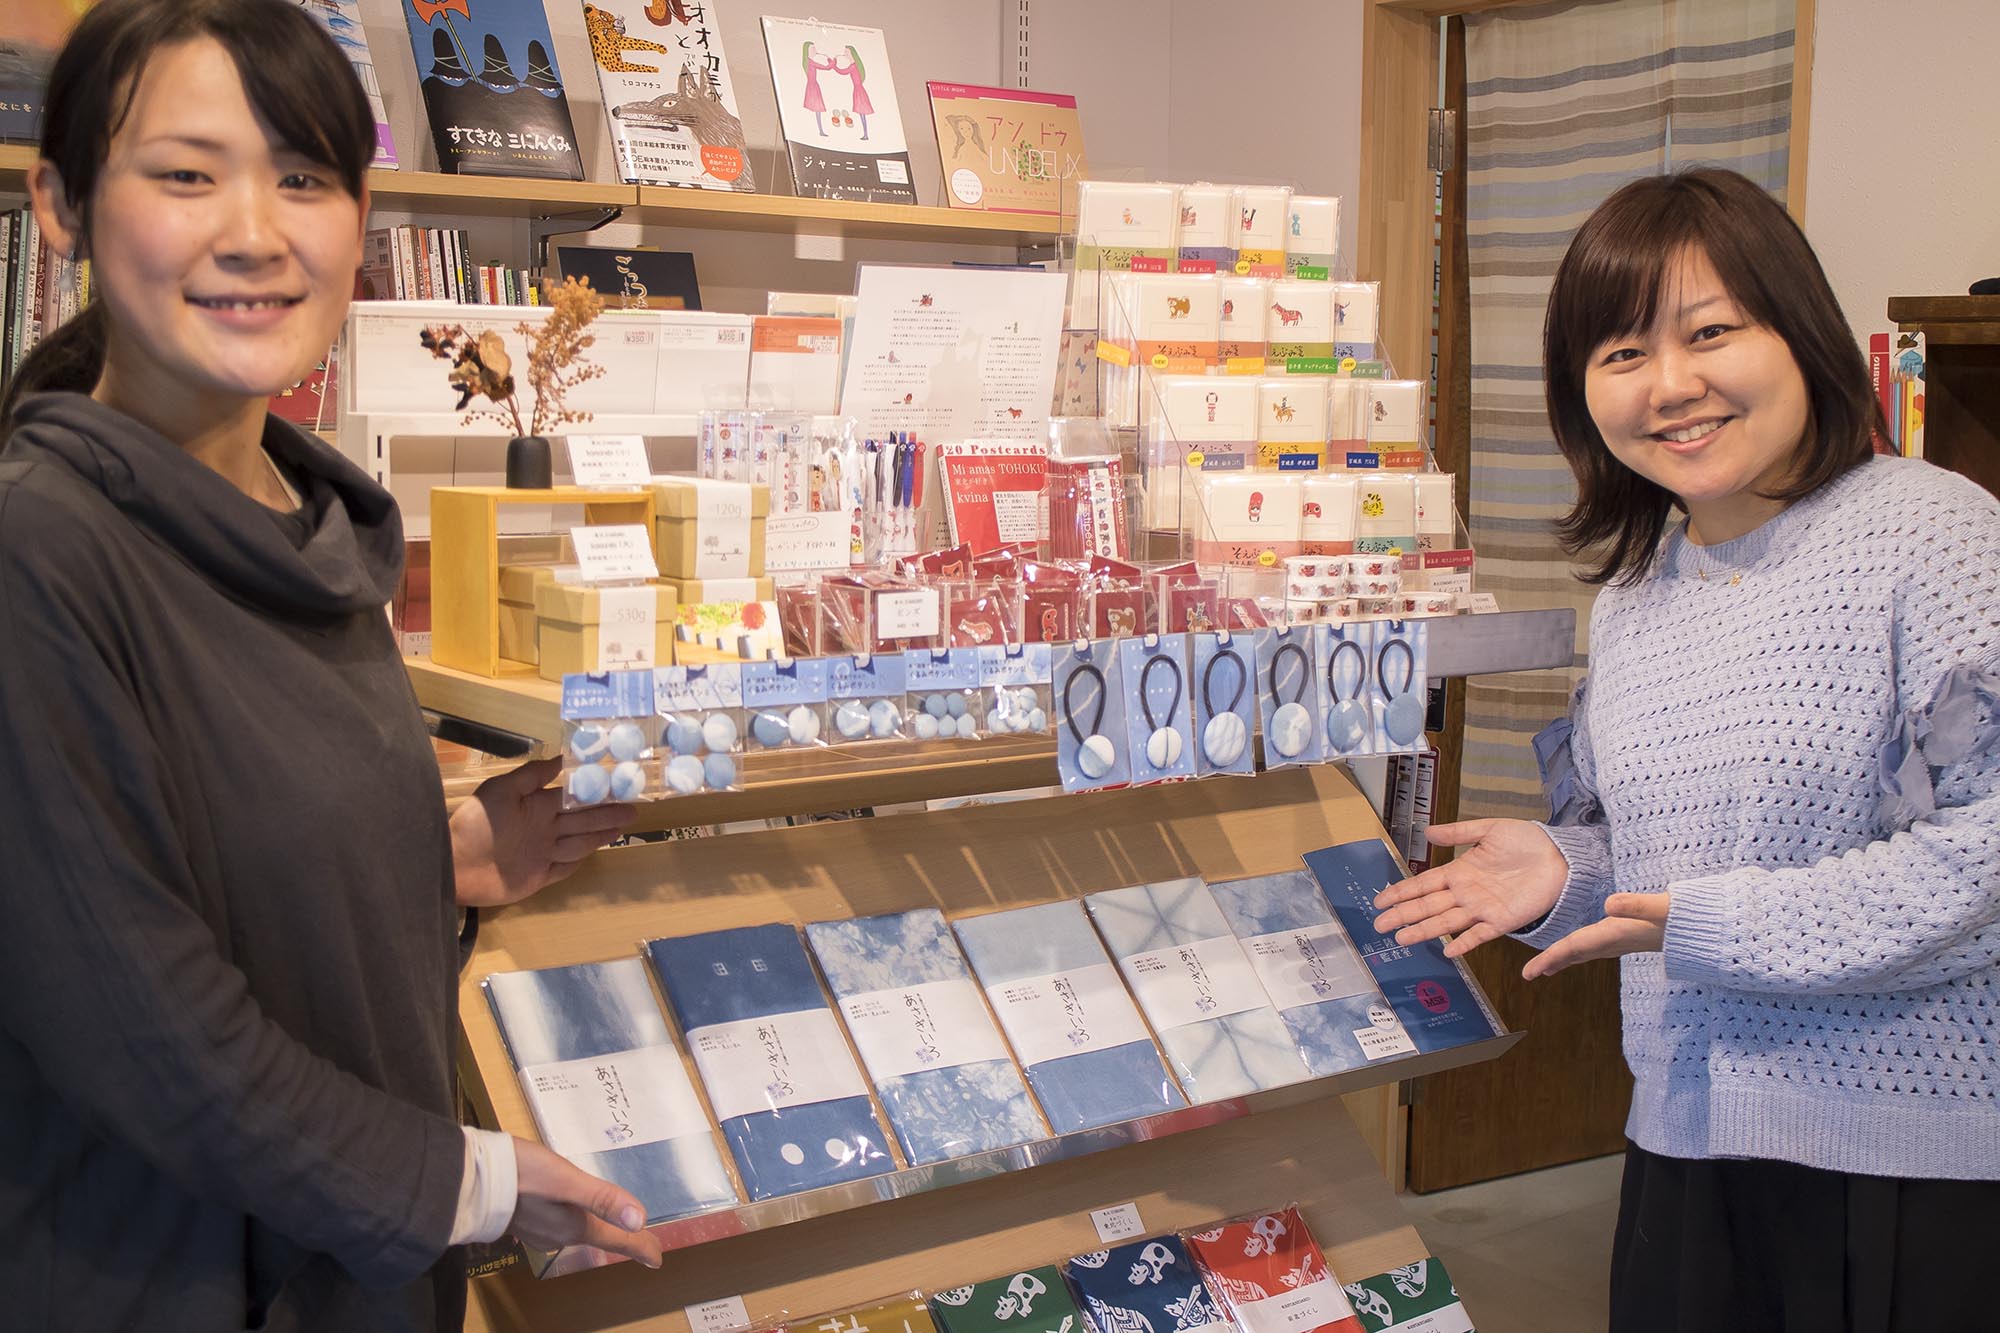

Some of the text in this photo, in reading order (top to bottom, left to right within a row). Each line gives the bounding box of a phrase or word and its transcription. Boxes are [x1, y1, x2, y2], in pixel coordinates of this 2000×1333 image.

[985, 115, 1024, 144] アン
[446, 125, 572, 152] すてきな 三にんぐみ
[803, 155, 869, 171] ジャーニー
[989, 146, 1019, 176] UN
[946, 444, 1047, 456] 20 Postcards
[952, 463, 1045, 476] Mi amas TOHOKU
[956, 490, 989, 505] kvina
[617, 607, 647, 624] 530g
